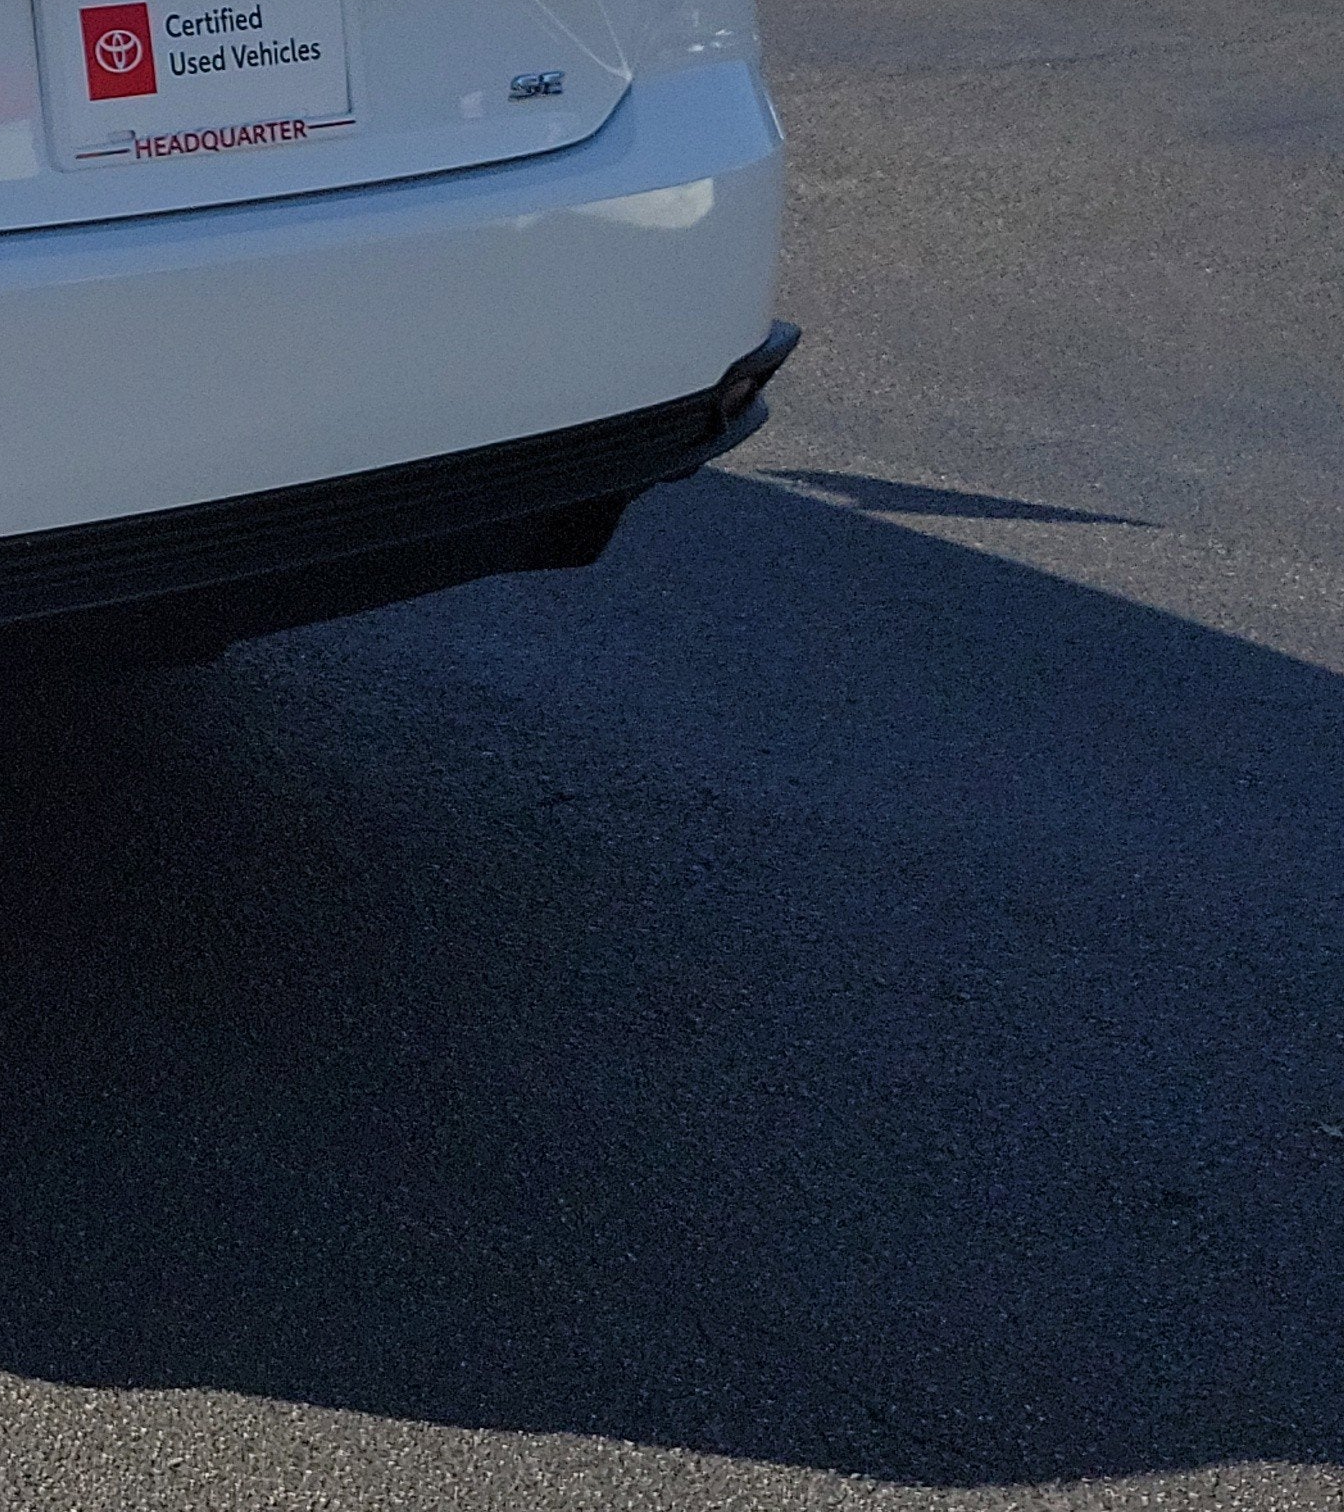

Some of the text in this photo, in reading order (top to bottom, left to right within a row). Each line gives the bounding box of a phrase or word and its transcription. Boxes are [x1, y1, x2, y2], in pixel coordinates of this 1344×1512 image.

[165, 4, 263, 38] Certified
[169, 37, 322, 76] Used Vehicles
[508, 70, 566, 103] SE
[134, 119, 308, 159] HEADQUARTER
